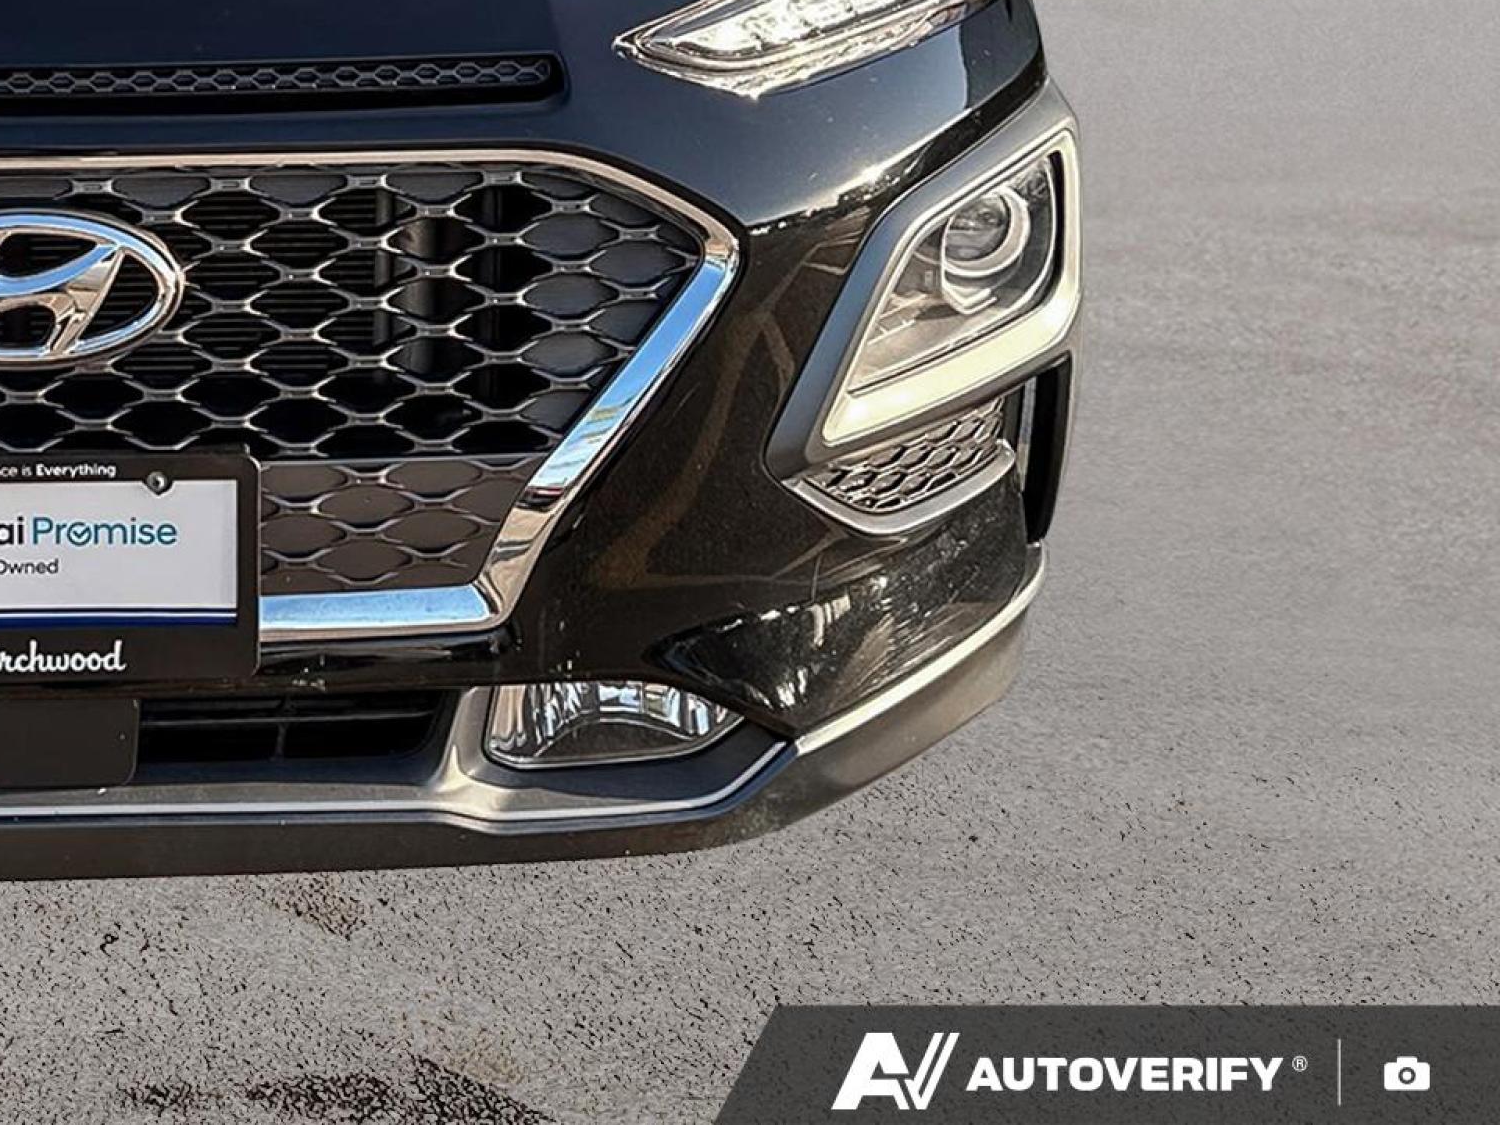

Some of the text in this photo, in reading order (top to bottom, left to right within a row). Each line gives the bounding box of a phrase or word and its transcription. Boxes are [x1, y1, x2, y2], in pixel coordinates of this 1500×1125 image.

[21, 464, 32, 478] is
[35, 463, 116, 480] Everything
[32, 516, 178, 546] Promise
